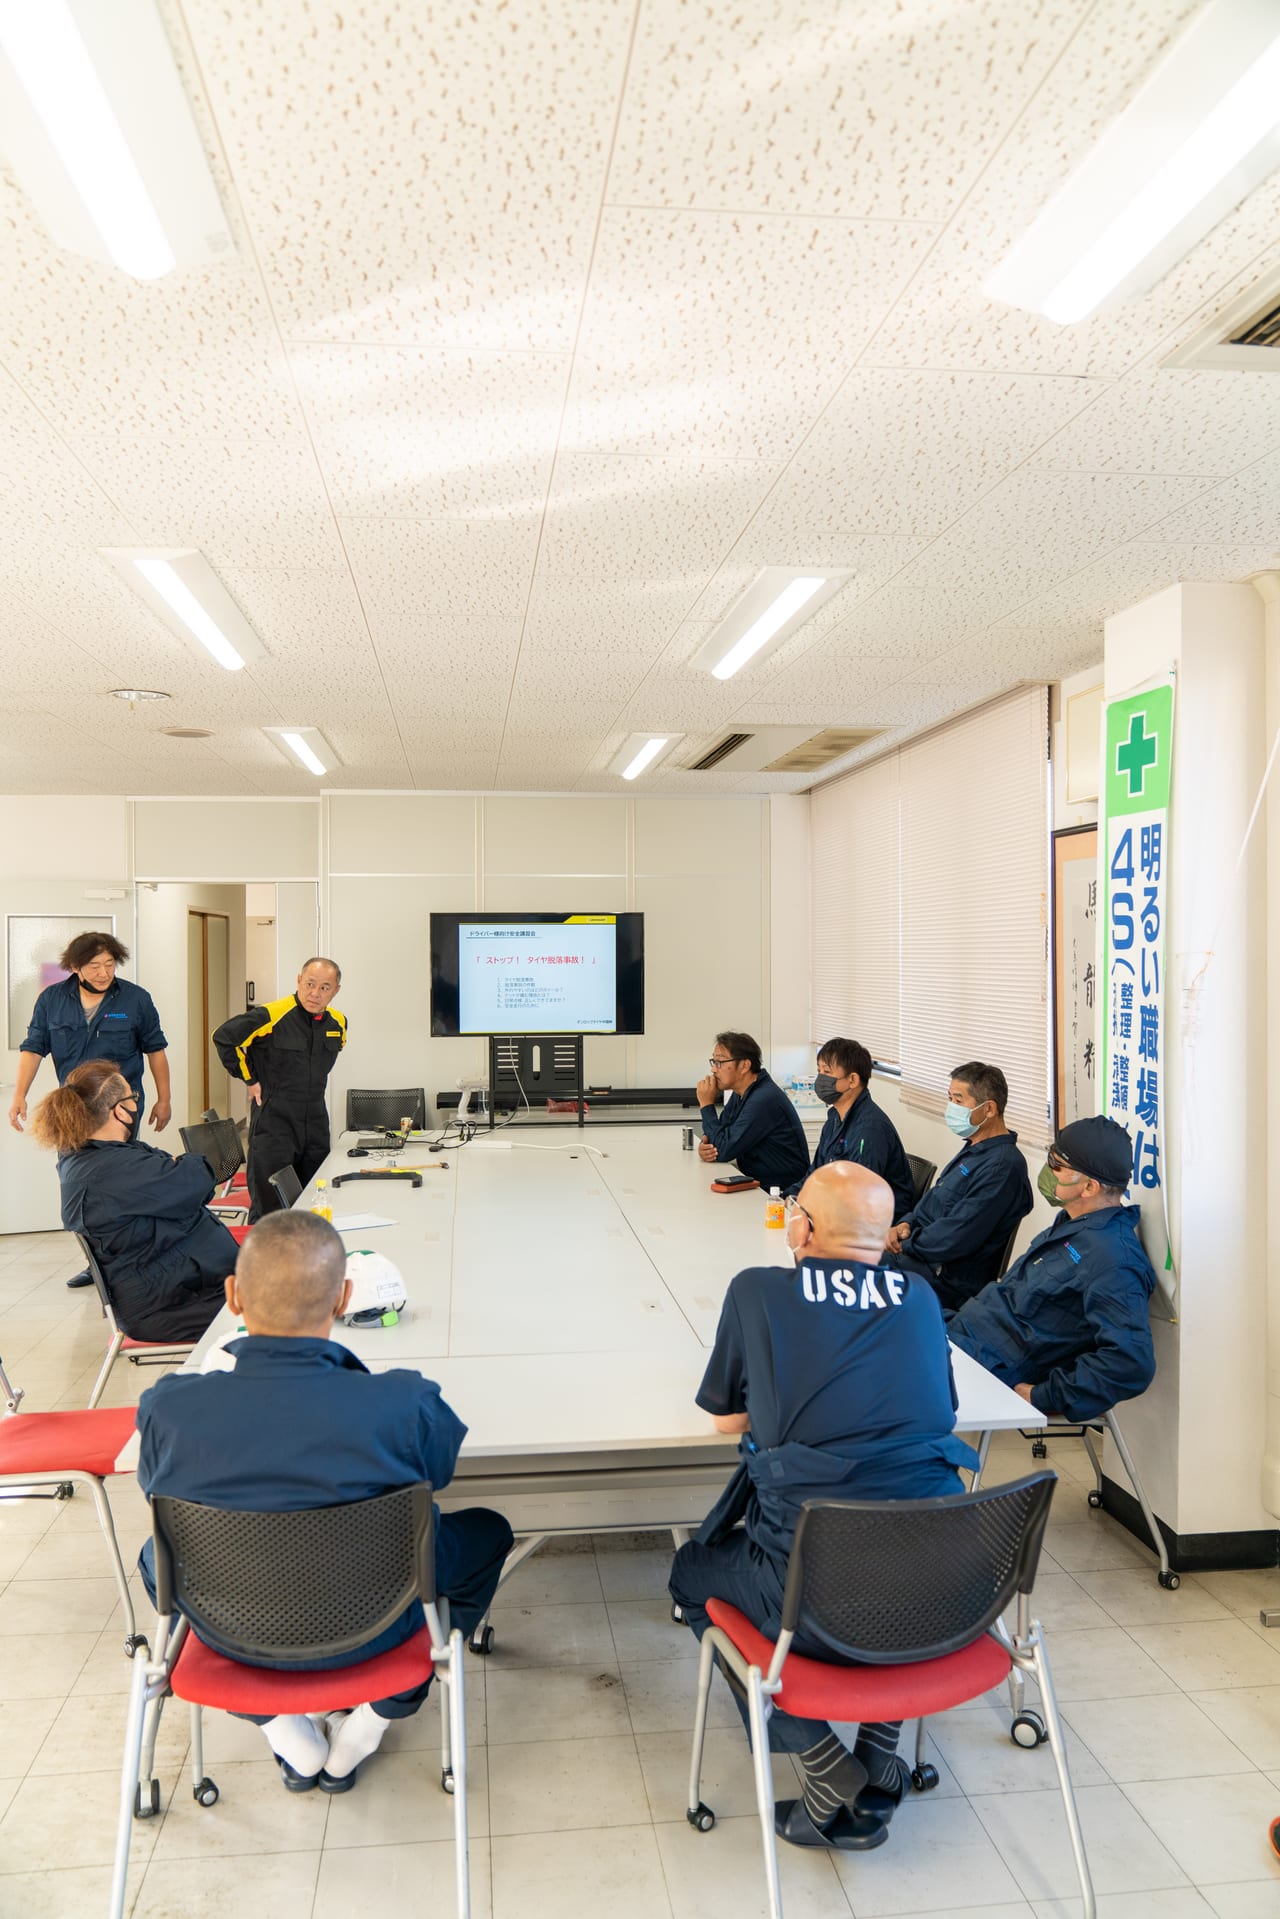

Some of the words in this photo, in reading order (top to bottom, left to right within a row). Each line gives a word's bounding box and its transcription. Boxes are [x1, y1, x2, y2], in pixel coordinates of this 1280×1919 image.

[1133, 823, 1162, 1190] 明るい職場は
[802, 1266, 905, 1310] USAF
